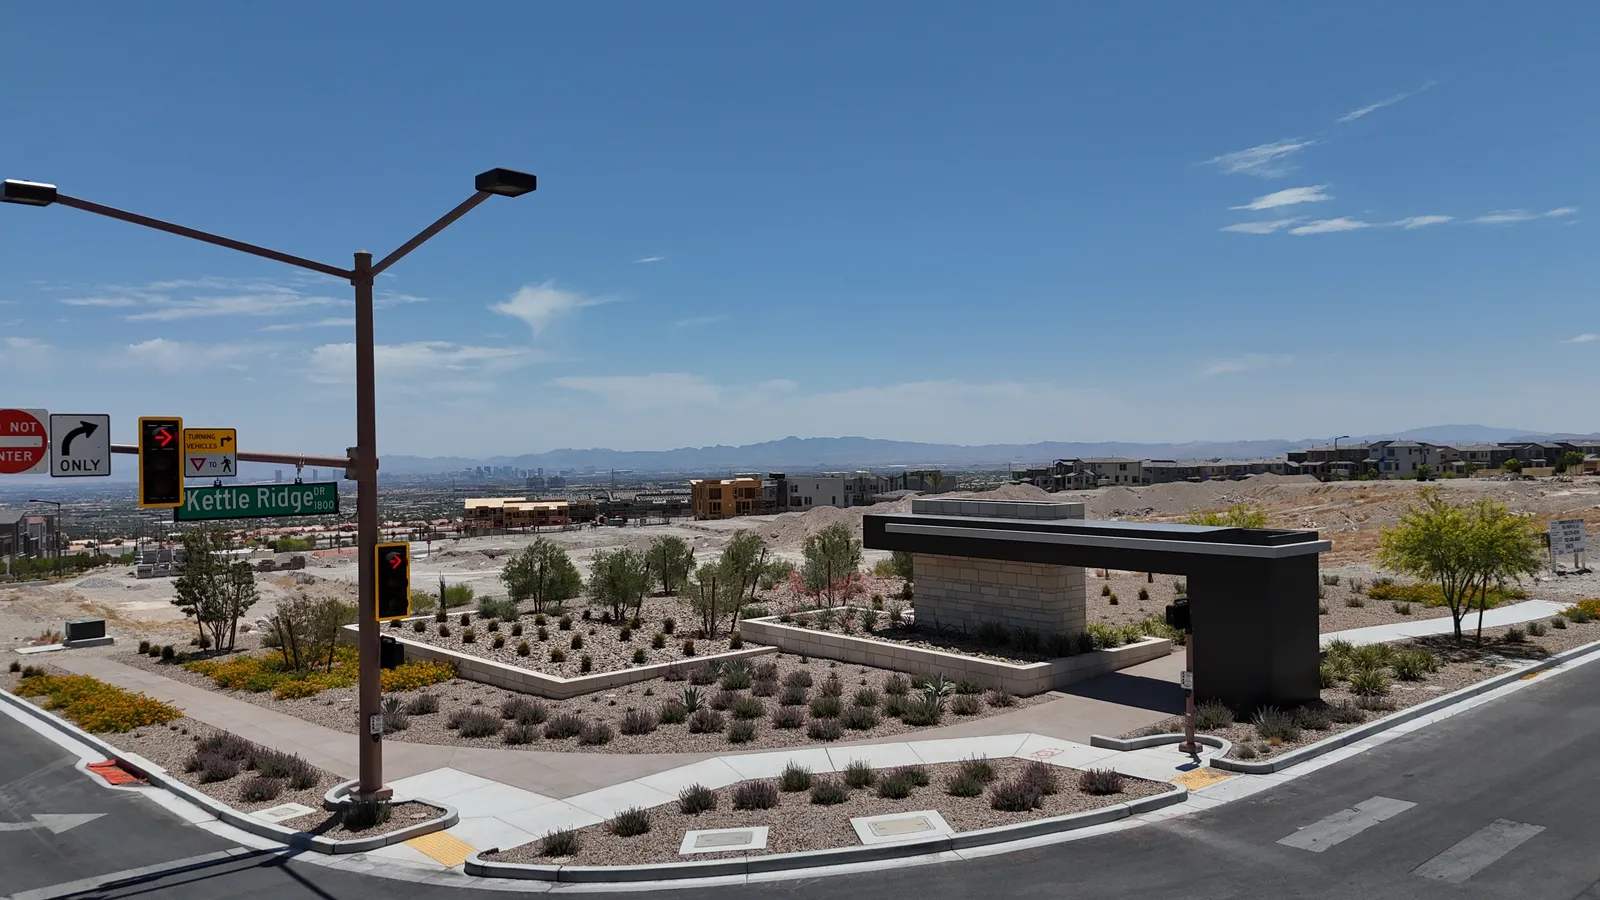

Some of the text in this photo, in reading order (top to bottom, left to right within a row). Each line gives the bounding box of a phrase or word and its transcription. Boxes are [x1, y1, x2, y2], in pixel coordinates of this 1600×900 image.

[10, 422, 37, 432] NOT
[0, 451, 32, 462] NTER
[60, 459, 100, 472] ONLY
[187, 486, 325, 512] Kettle Ridge DR
[314, 500, 335, 510] 1800
